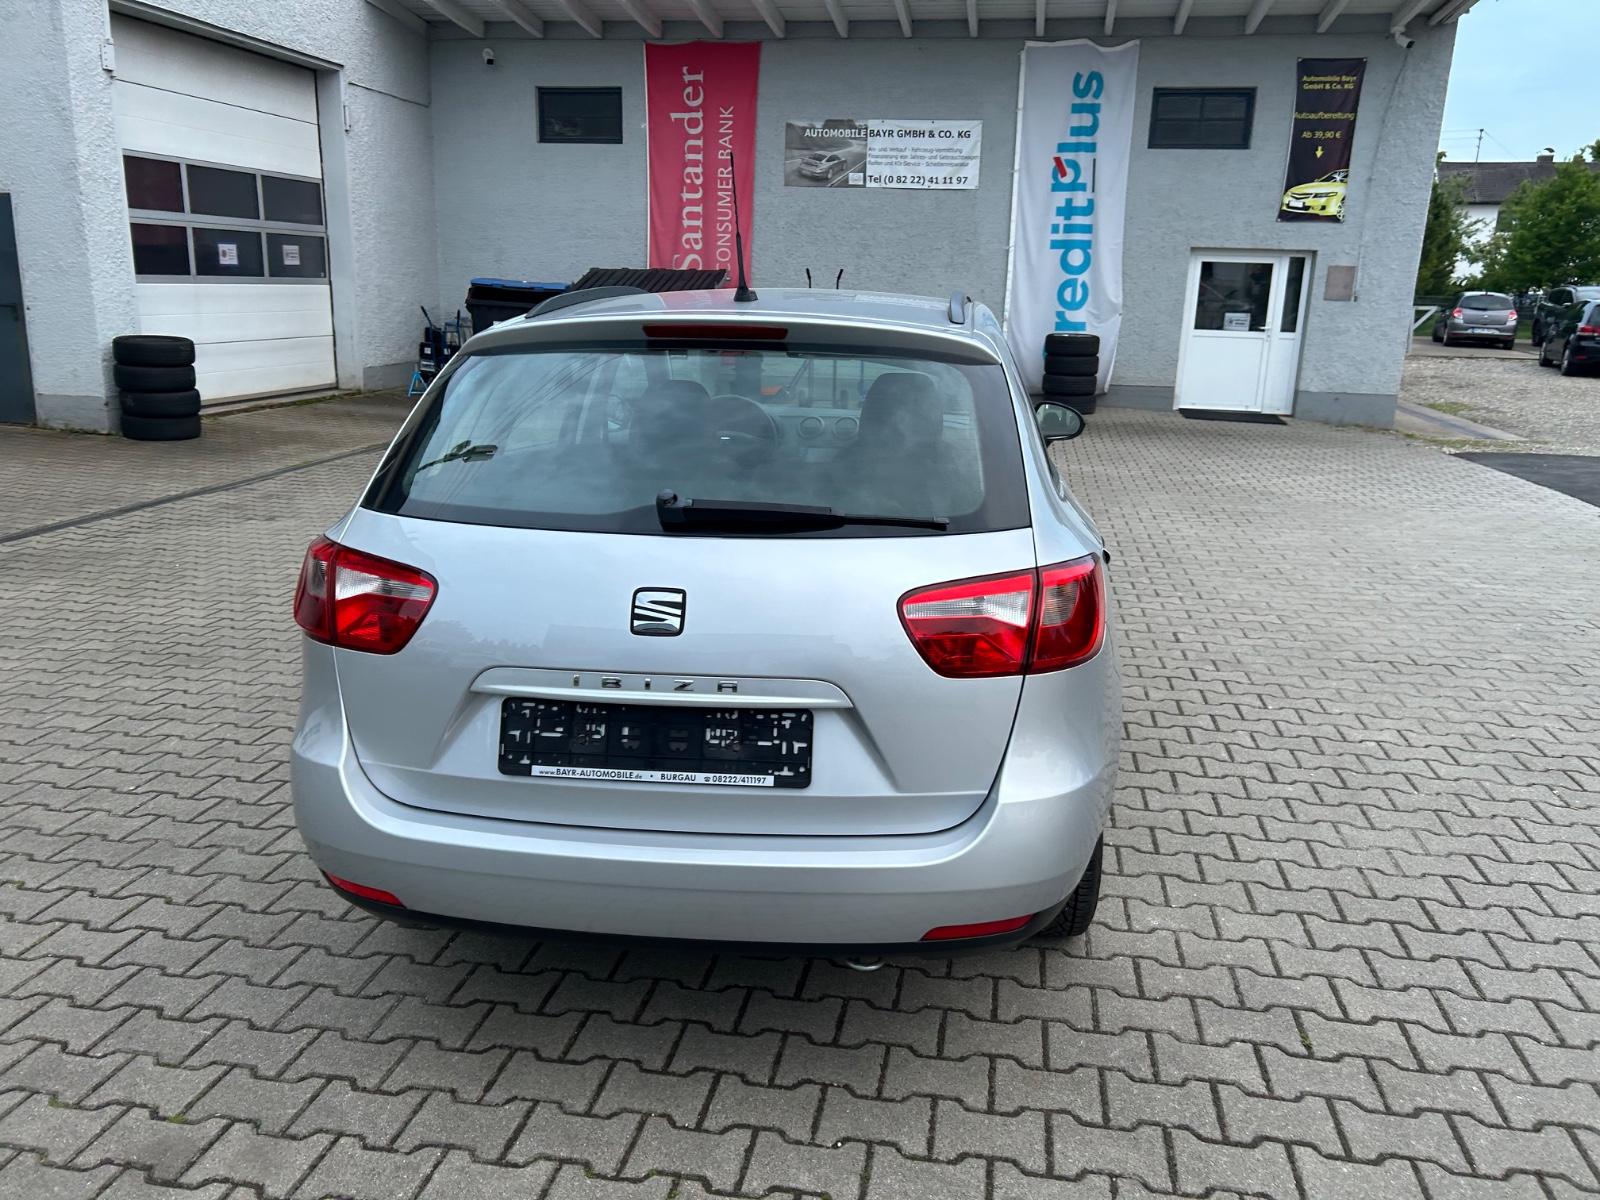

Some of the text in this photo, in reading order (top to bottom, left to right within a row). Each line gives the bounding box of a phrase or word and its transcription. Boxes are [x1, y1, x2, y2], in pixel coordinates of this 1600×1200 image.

[718, 105, 734, 159] BANK
[804, 128, 972, 139] AUTOMOBILE BAYR GMBH & CO. KG
[1301, 131, 1312, 139] Ab
[1313, 131, 1335, 140] 39,90
[670, 65, 704, 270] Santander
[868, 175, 969, 186] Tel (0 82 22) 41 11 97
[1048, 70, 1105, 332] reditplus
[573, 674, 738, 693] IBIZA
[660, 772, 697, 783] BURGAU
[711, 774, 767, 785] 08222/411197
